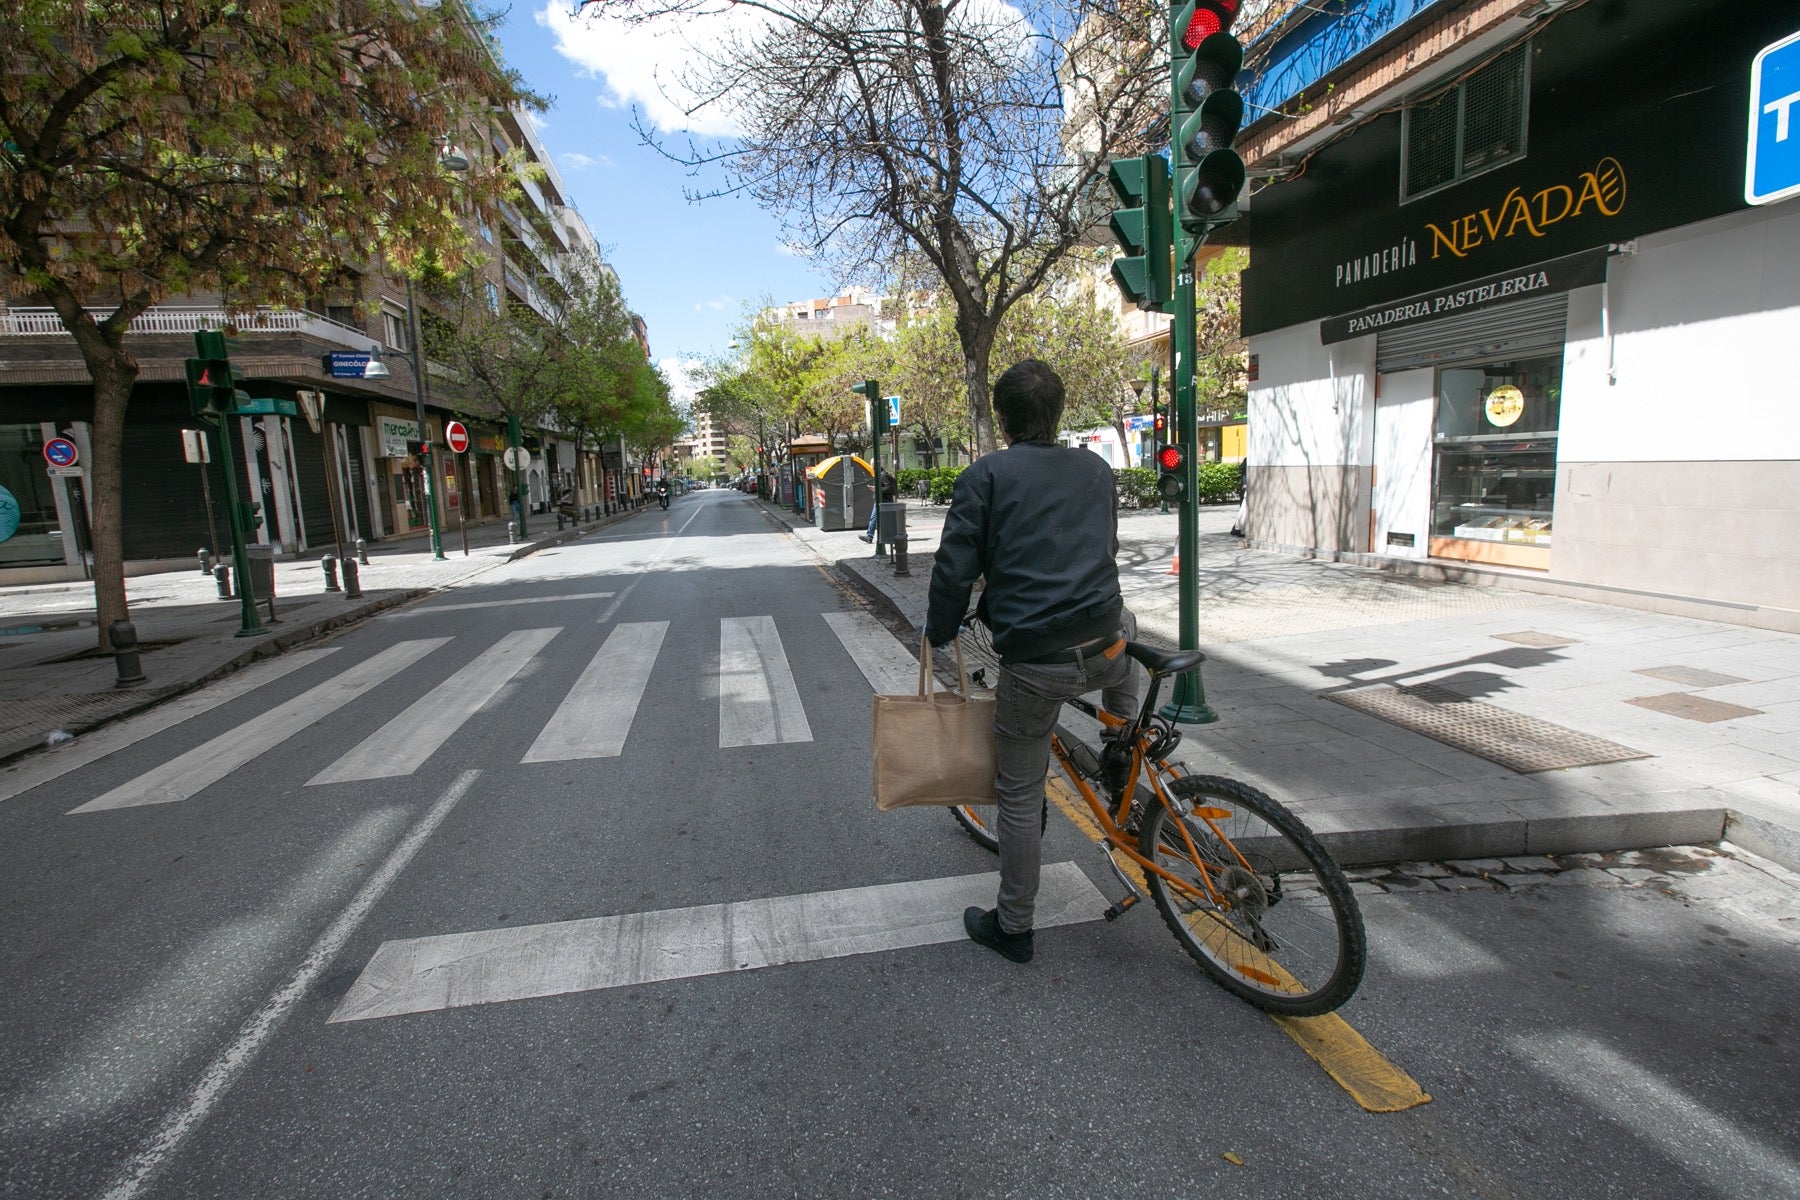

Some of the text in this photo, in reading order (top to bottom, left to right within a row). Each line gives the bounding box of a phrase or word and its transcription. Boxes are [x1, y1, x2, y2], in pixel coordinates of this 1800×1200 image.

[1336, 171, 1616, 287] PANADERÍA NEVADA
[1348, 271, 1549, 333] PANADERIA PASTELERIA
